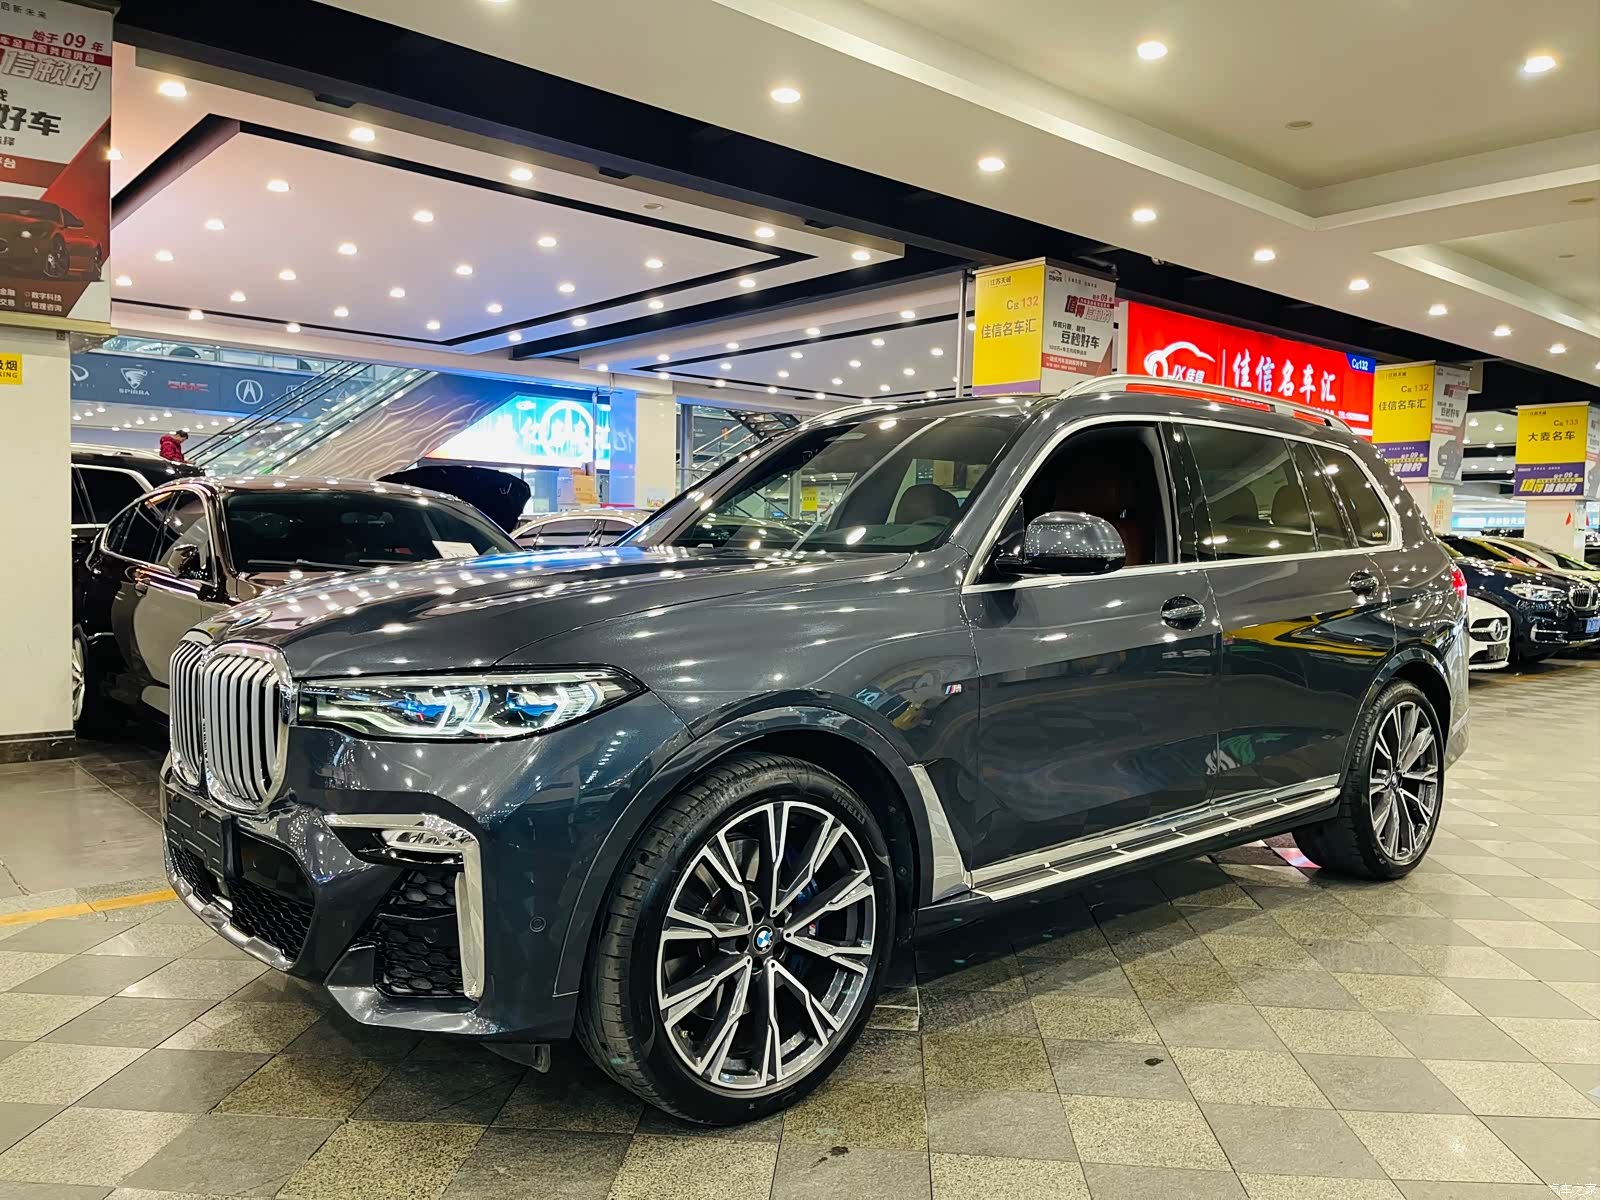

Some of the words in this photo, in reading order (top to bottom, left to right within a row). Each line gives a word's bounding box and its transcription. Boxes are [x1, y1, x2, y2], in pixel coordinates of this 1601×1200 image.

[32, 29, 59, 43] 始于
[63, 32, 86, 48] 09
[91, 41, 104, 52] 年
[0, 104, 61, 136] 好车
[1022, 295, 1039, 308] 132
[982, 318, 1037, 340] 佳信名车汇
[1232, 348, 1337, 403] 佳信名车汇
[118, 388, 150, 396] SPIRRA
[1415, 383, 1430, 392] 132
[1379, 398, 1427, 411] 佳信名车汇
[1528, 430, 1576, 442] 大麦名车
